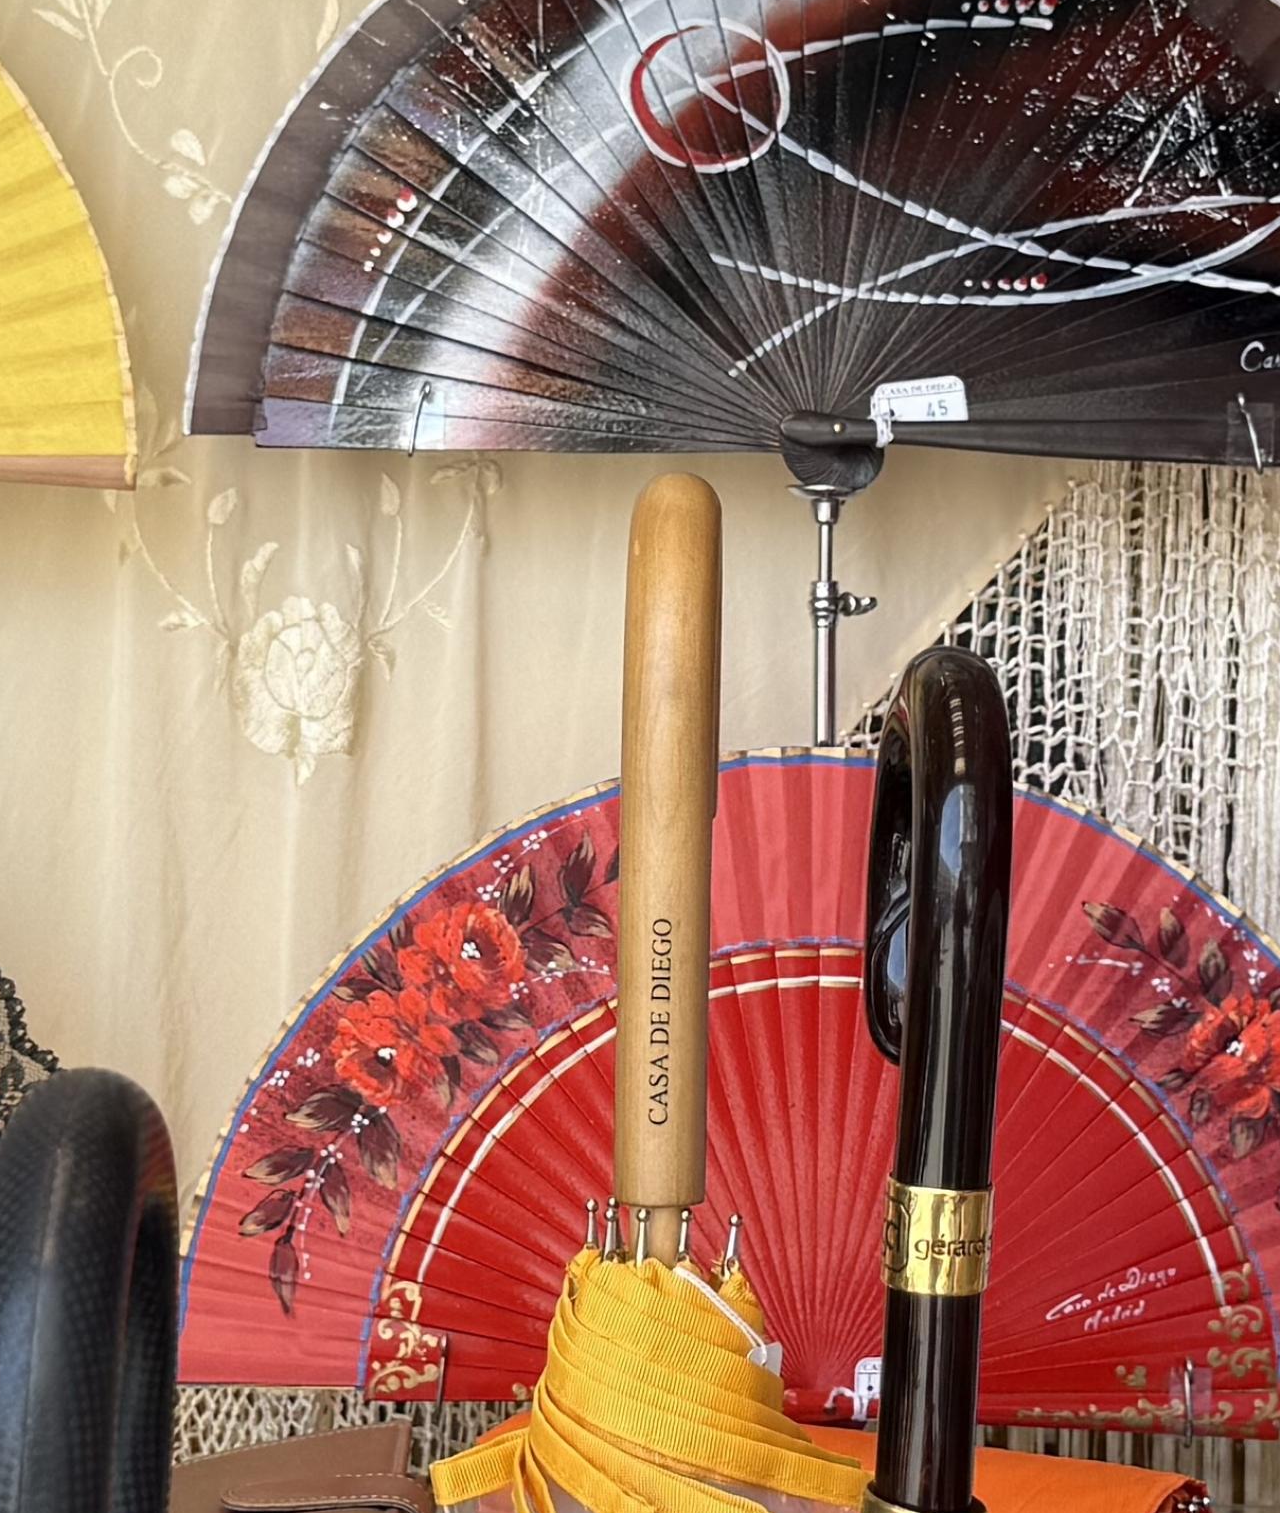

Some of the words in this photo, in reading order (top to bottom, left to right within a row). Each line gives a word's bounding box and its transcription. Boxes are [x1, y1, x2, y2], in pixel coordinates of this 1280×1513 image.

[927, 398, 949, 418] 45
[650, 917, 673, 1002] DIEGO
[649, 1010, 671, 1046] DE
[648, 1053, 669, 1126] CASA
[913, 1232, 987, 1261] gérard
[1118, 1267, 1177, 1292] Diego
[1084, 1299, 1146, 1332] Madrid
